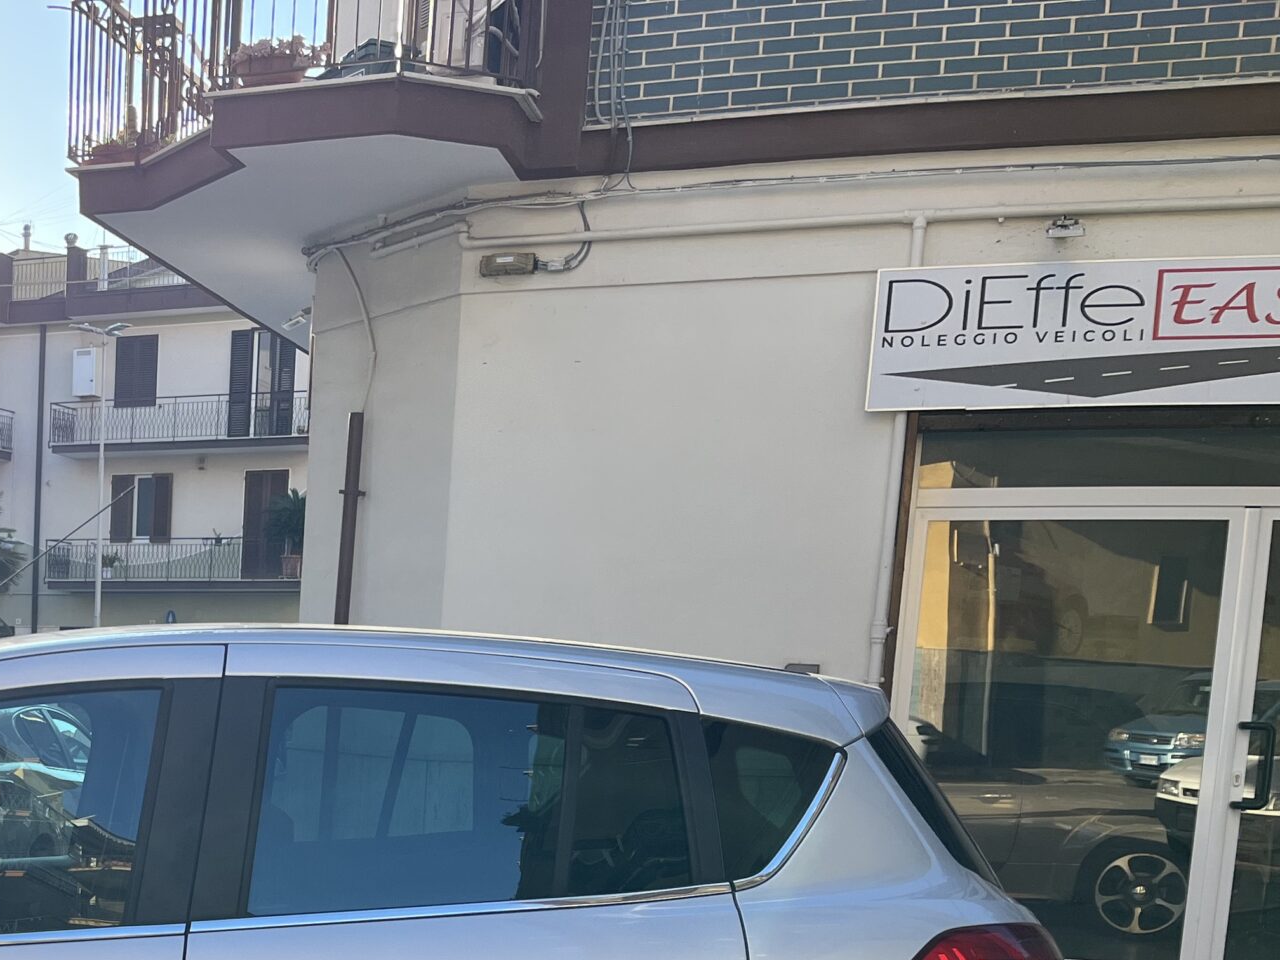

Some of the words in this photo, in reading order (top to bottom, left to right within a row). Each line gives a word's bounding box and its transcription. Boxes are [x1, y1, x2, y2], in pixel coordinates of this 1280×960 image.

[884, 273, 1145, 333] DiEffe
[881, 332, 1019, 348] NOLEGGIO
[1036, 328, 1145, 344] VEICOLI
